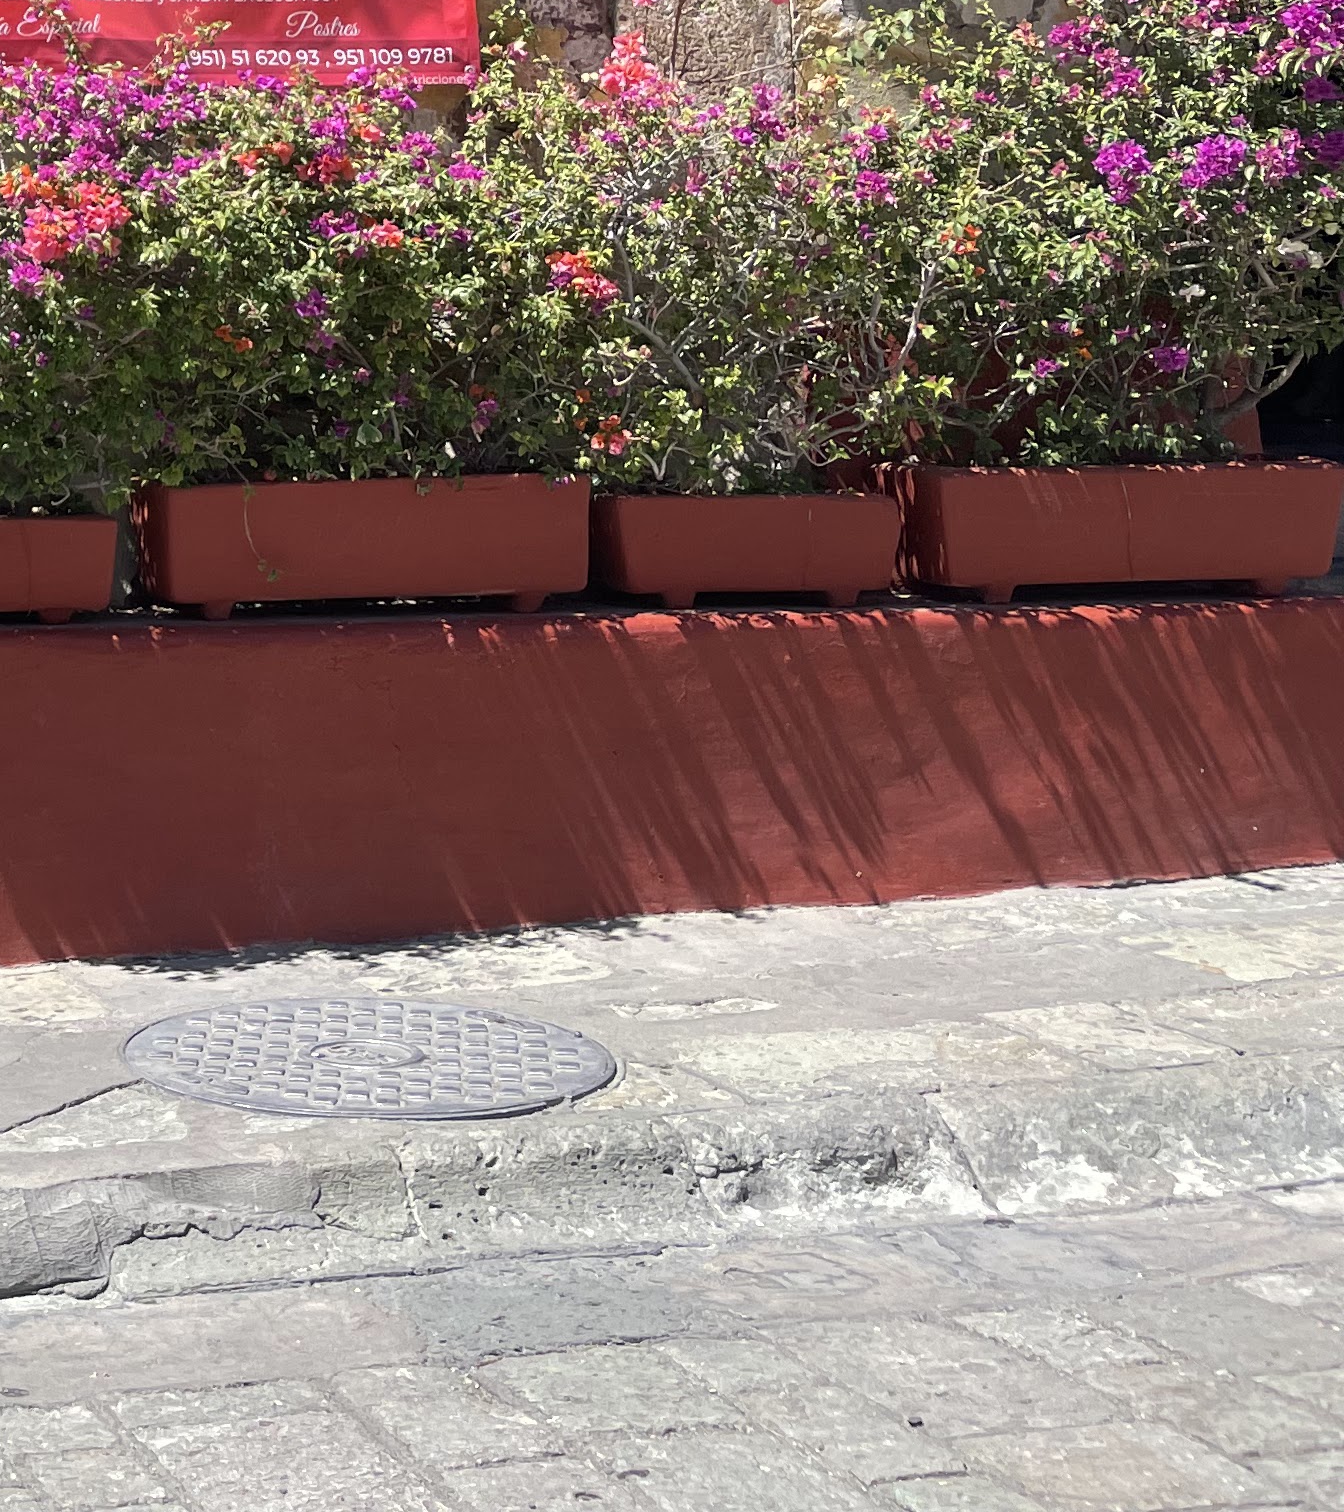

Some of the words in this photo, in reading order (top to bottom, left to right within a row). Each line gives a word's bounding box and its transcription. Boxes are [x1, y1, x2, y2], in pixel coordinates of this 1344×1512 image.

[16, 7, 101, 43] Espcial
[286, 10, 360, 38] Postres
[185, 49, 226, 69] (951)
[231, 49, 250, 66] 51
[255, 49, 291, 66] 620
[296, 49, 320, 66] 93
[334, 49, 364, 66] 951
[370, 48, 403, 65] 109
[408, 47, 453, 65] 9781
